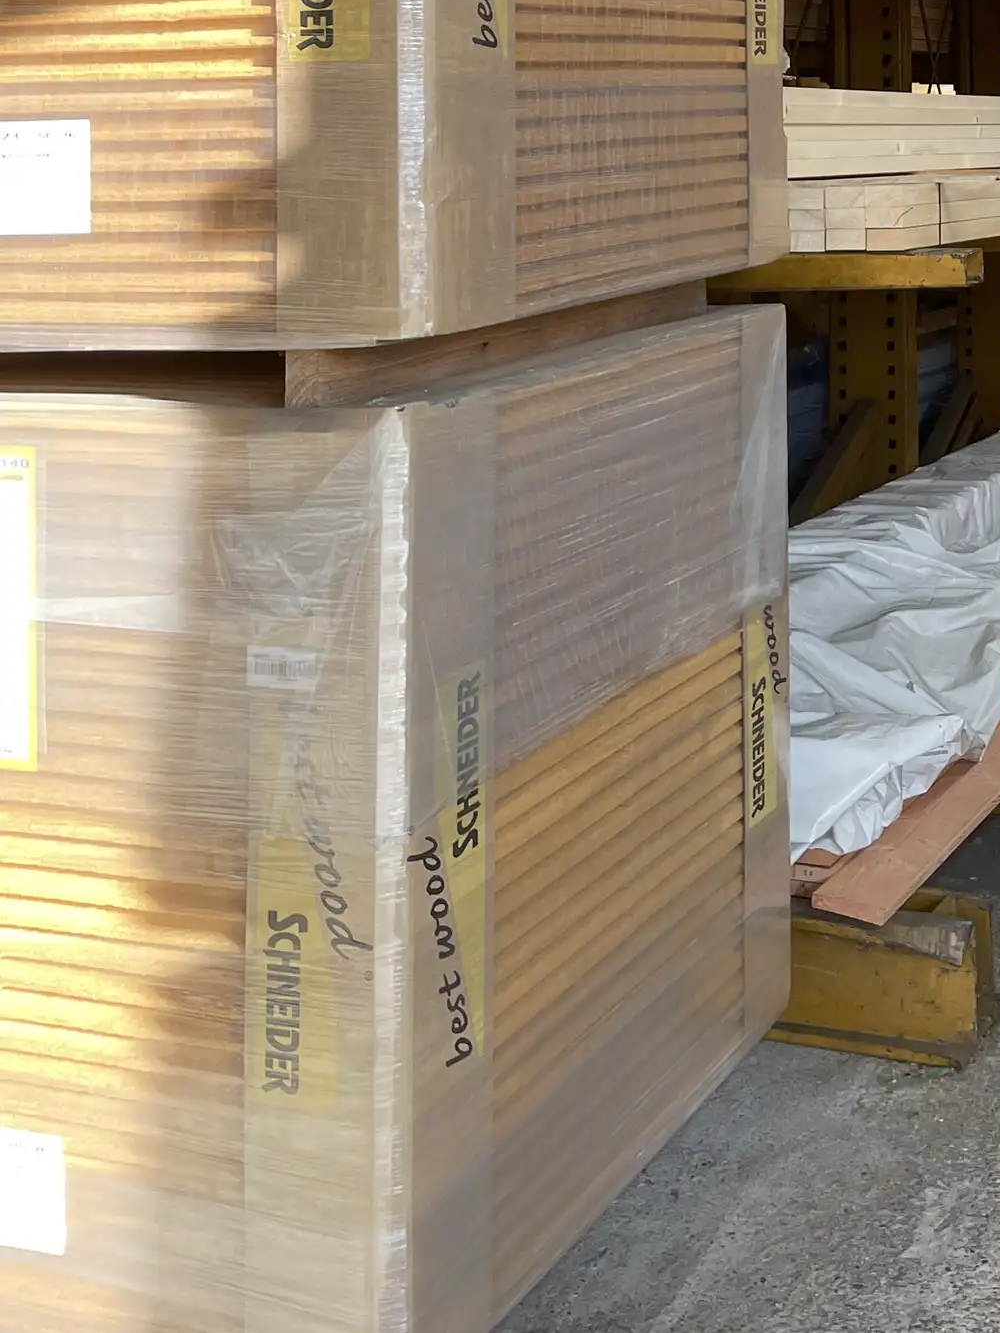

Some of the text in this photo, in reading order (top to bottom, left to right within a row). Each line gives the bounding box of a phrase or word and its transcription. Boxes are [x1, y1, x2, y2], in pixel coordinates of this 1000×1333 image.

[763, 604, 787, 695] wood
[452, 670, 482, 859] SCHNEIDER
[751, 676, 767, 818] SCHNEIDER
[304, 817, 374, 960] wood
[407, 836, 473, 1068] best wood
[262, 909, 308, 1096] SCHNEIDER
